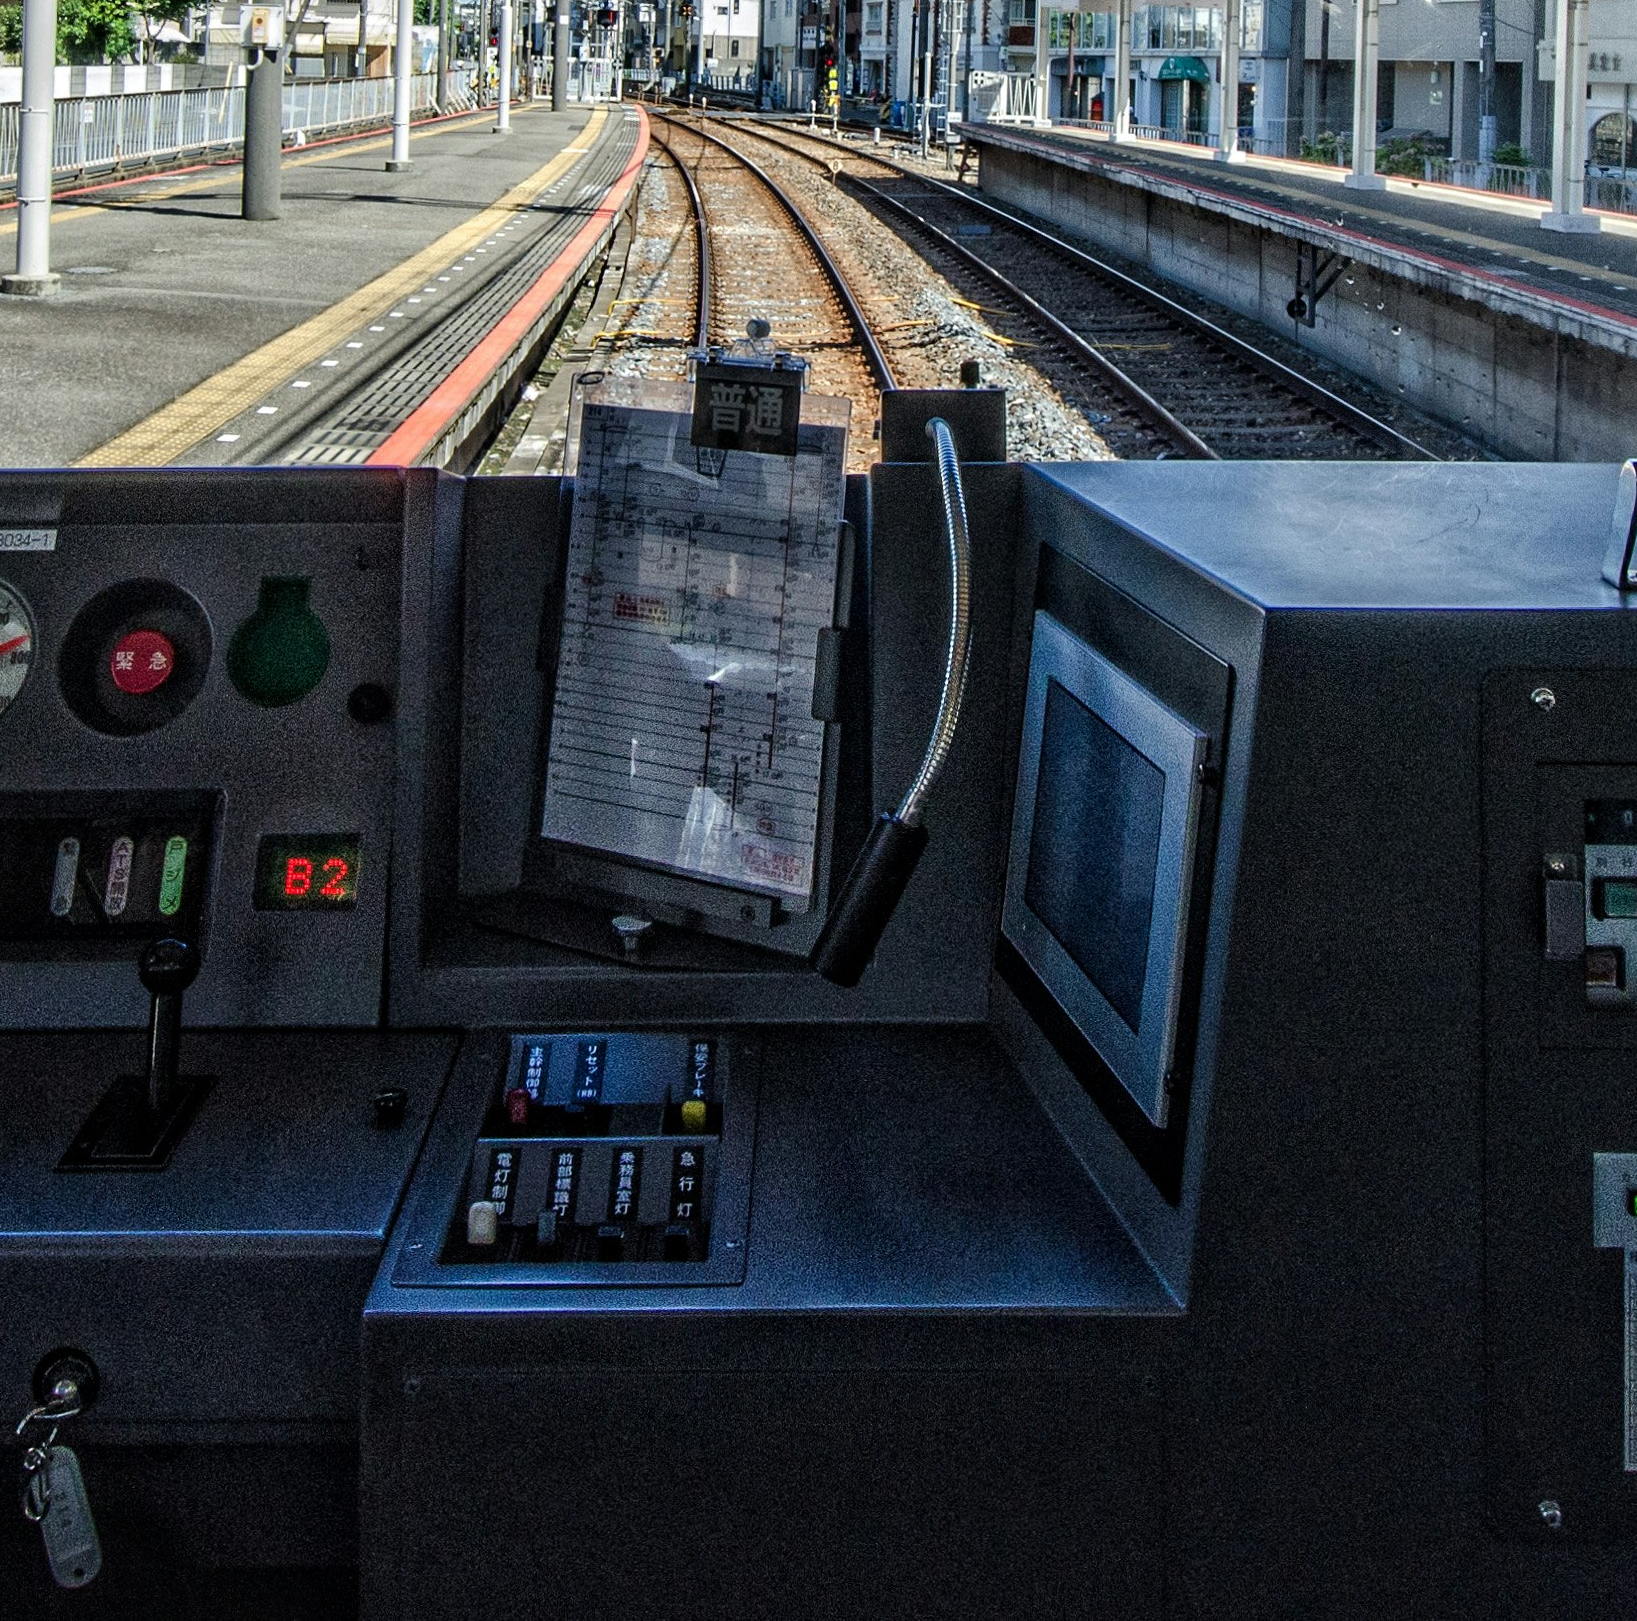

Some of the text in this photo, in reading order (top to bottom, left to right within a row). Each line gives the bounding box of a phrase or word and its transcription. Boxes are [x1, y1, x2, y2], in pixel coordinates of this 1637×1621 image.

[709, 382, 784, 437] 普通
[115, 650, 167, 671] 緊急
[162, 841, 184, 910] 戸ジメ
[284, 857, 348, 895] B2
[583, 1045, 598, 1086] リセット
[676, 1152, 696, 1218] 急行灯
